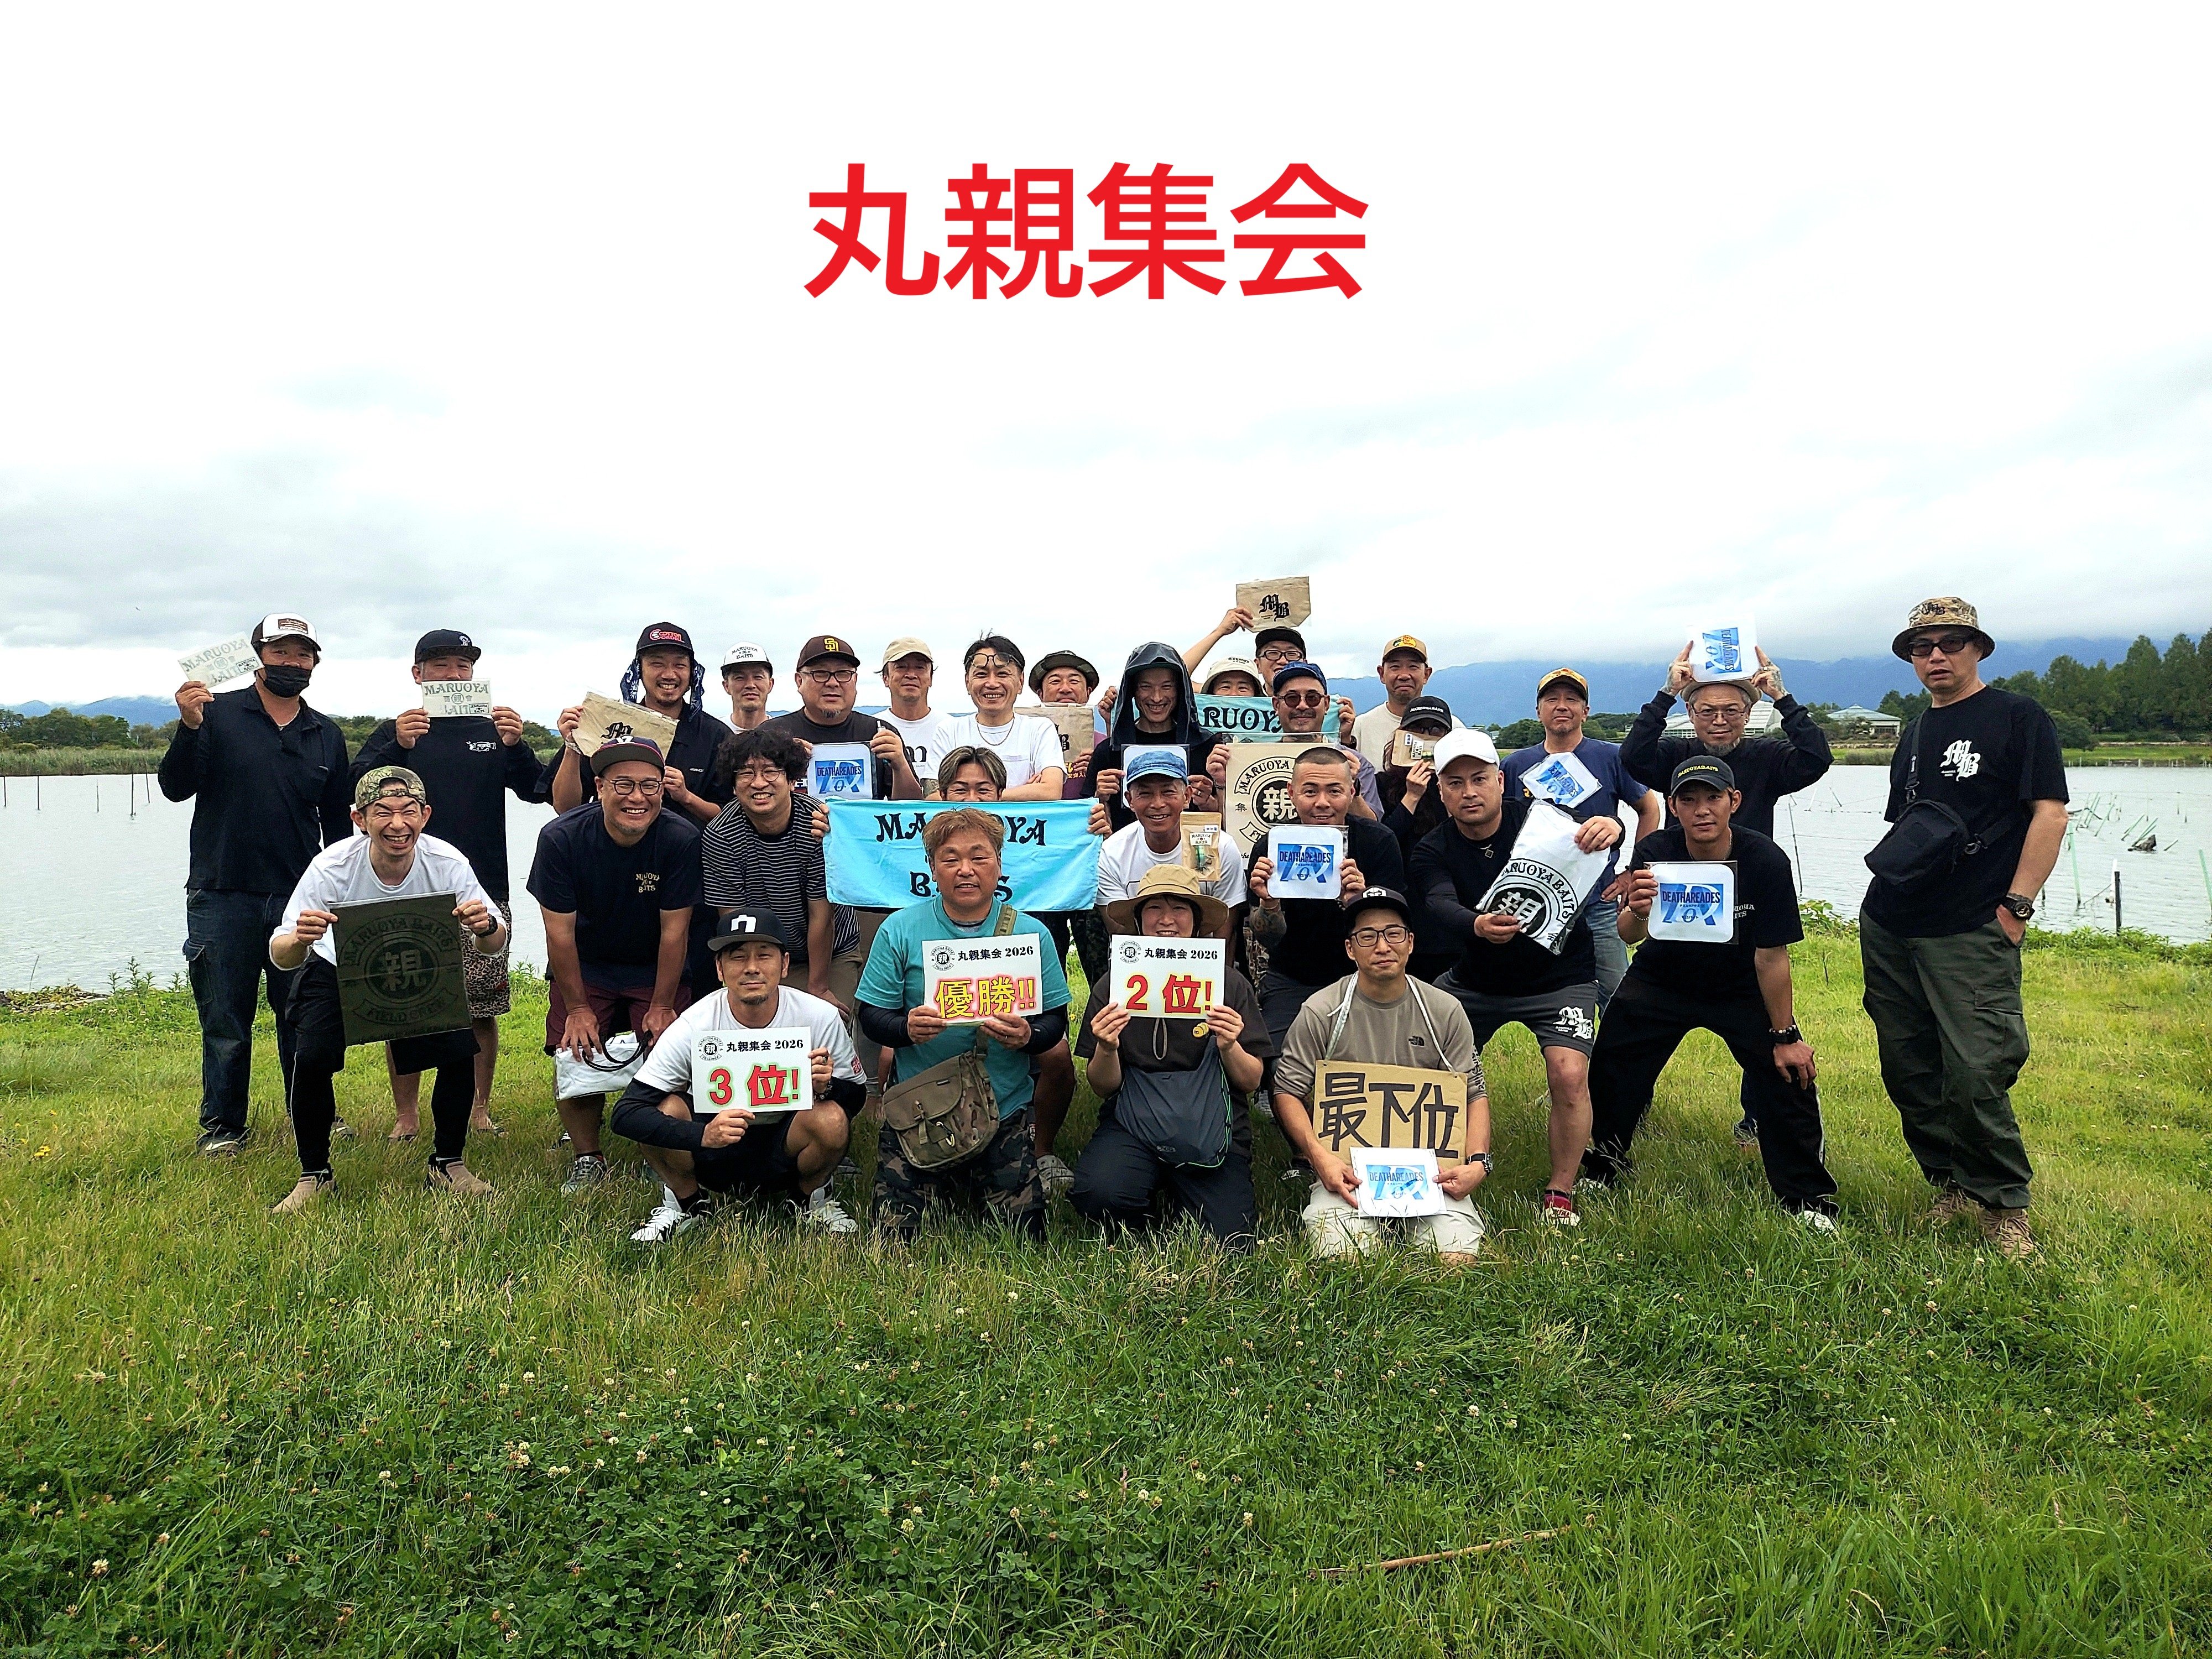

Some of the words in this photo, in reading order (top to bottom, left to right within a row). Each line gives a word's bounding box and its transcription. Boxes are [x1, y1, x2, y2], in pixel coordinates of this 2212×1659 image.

[181, 638, 249, 672] MARUOYA
[424, 682, 489, 696] MARUOYA
[817, 765, 862, 776] DEATHAREADES
[1238, 759, 1290, 791] MARUOYA
[1262, 786, 1298, 821] 親
[873, 812, 1048, 846] MAYA
[1279, 851, 1332, 863] DEATHAREADES
[1662, 890, 1720, 904] DEATHAREADES
[957, 948, 1002, 961] 丸親集会
[1005, 946, 1034, 957] 2026
[1144, 947, 1188, 960] 丸親集会
[1190, 950, 1218, 960] 2026
[382, 948, 427, 992] 親
[1125, 974, 1149, 1010] 2
[726, 1040, 771, 1052] 丸親集会
[775, 1039, 804, 1050] 2026
[709, 1068, 733, 1105] 3
[1318, 1072, 1460, 1159] 最下位
[1369, 1171, 1425, 1182] DEATHAREADES
